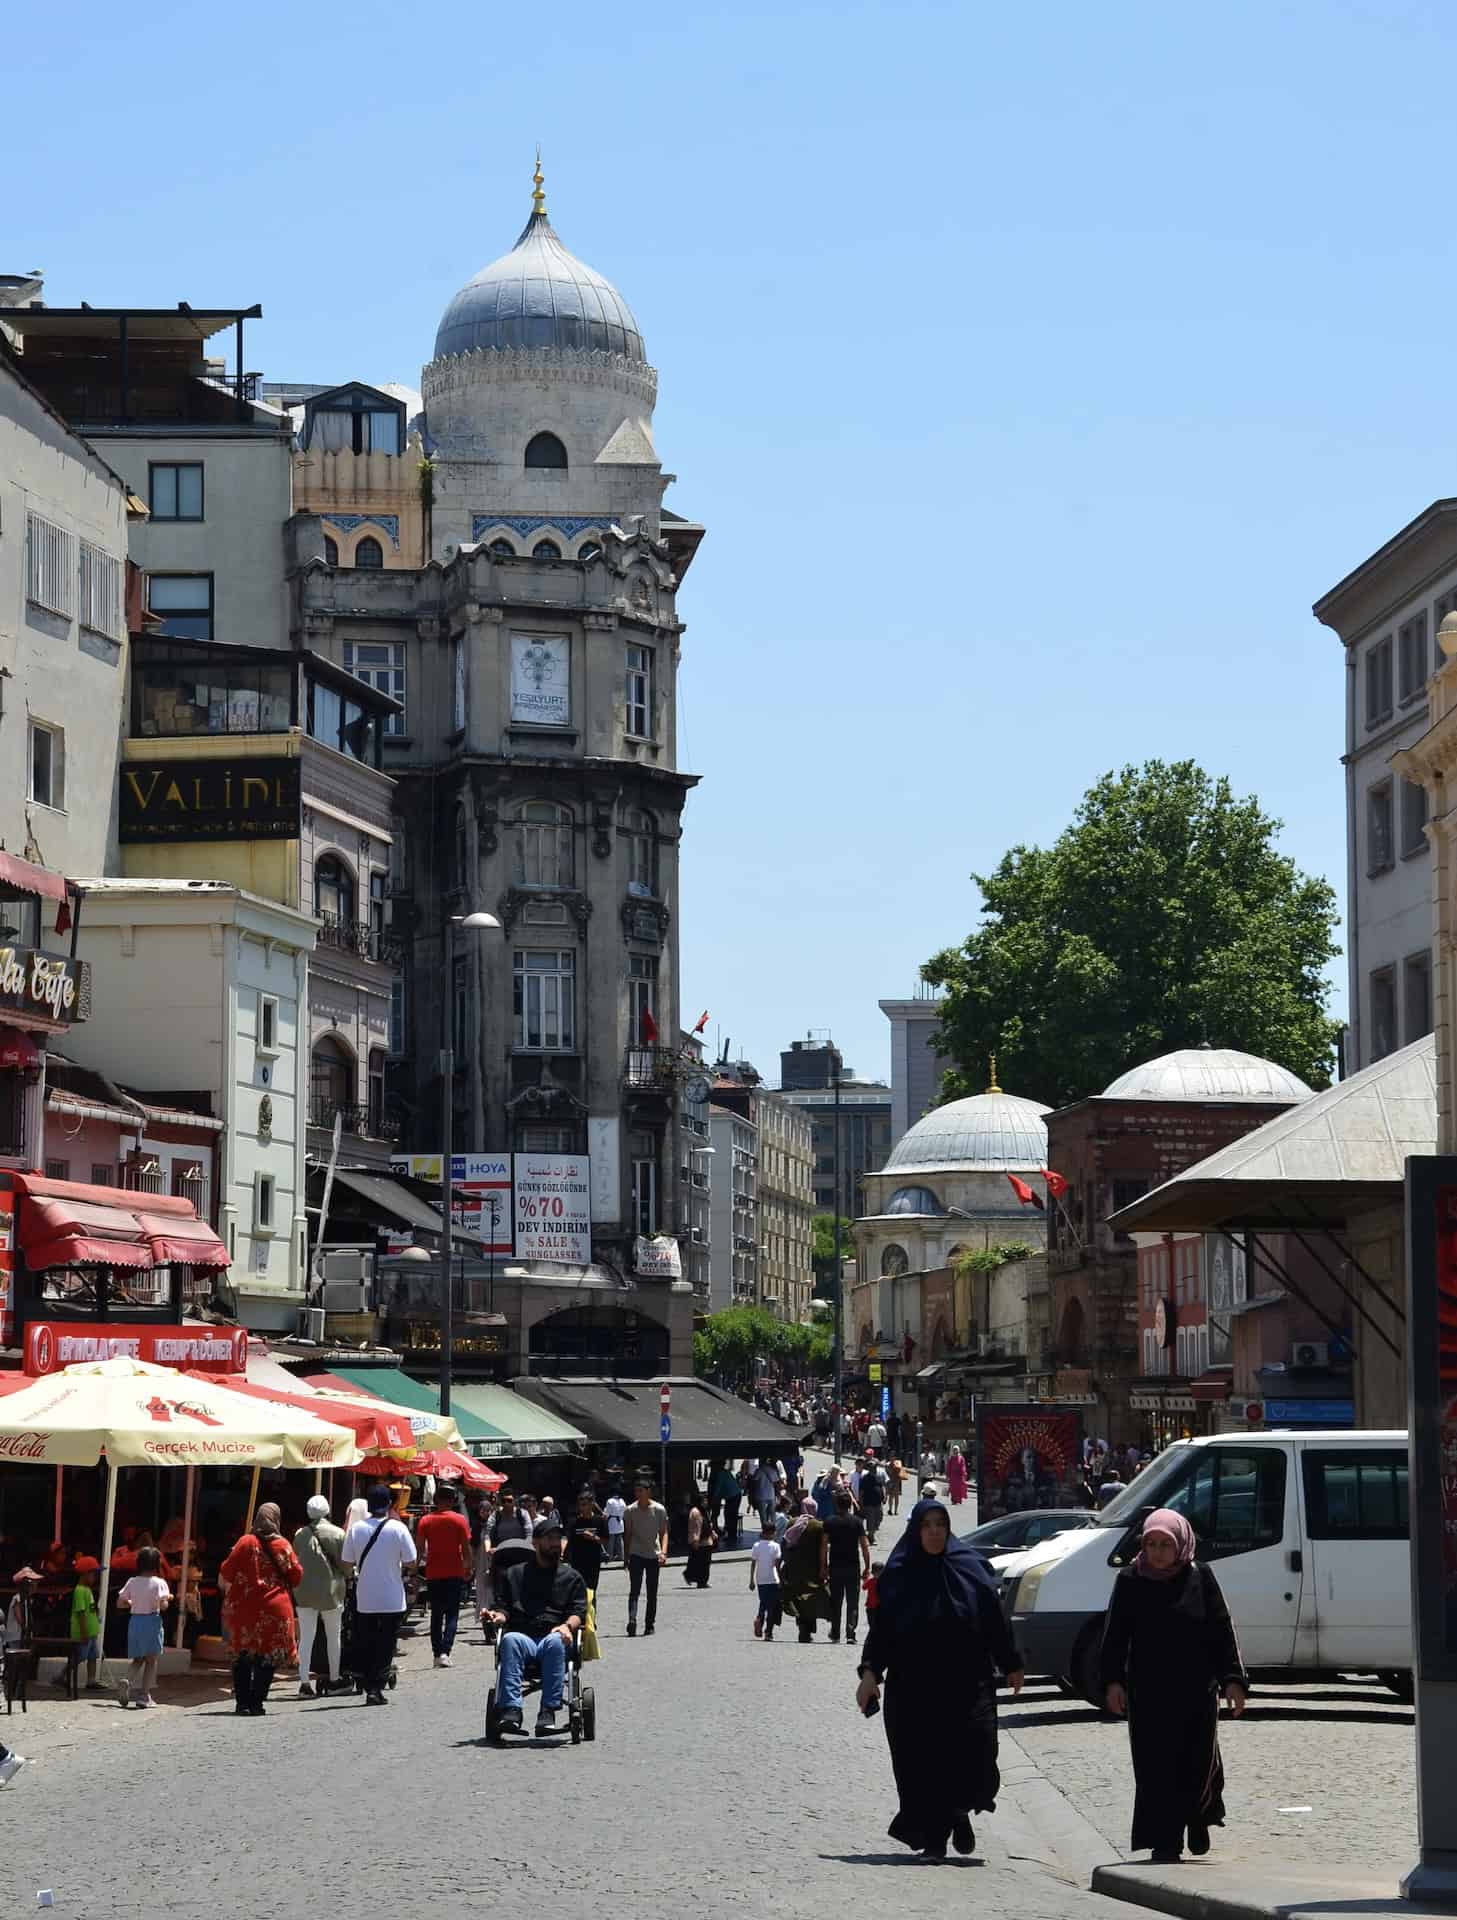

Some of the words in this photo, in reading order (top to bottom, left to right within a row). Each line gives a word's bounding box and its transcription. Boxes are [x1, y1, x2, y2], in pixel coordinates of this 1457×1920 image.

[470, 1163, 507, 1174] HOYA
[517, 1222, 540, 1233] DEV
[543, 1218, 589, 1234] İNDİRİM
[538, 1236, 568, 1248] SALE
[526, 1249, 582, 1260] SUNGLASSES
[144, 1440, 198, 1456] Gerçek
[202, 1441, 256, 1454] Mucize
